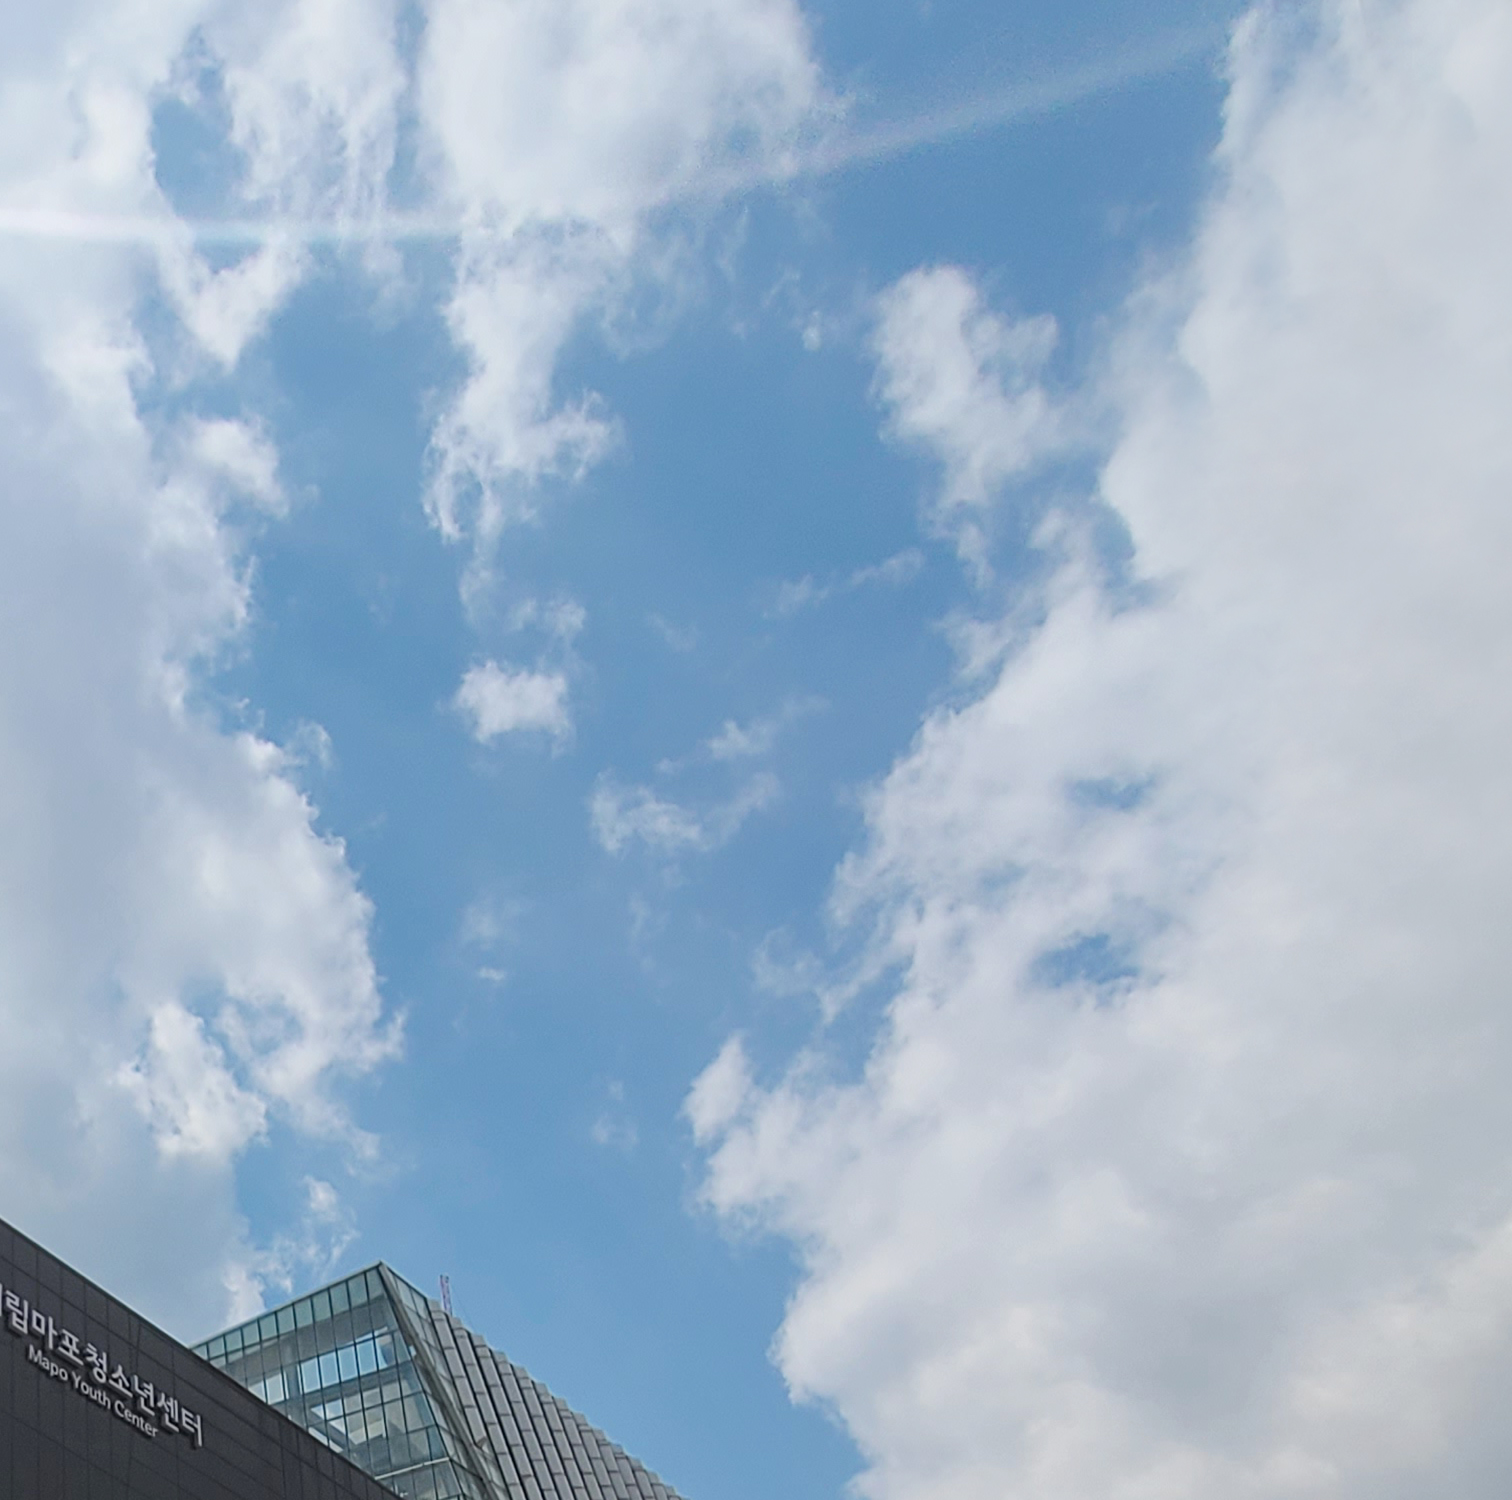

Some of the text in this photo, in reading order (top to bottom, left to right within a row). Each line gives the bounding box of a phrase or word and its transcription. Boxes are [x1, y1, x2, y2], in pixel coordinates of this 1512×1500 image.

[28, 1344, 159, 1438] Mapo Youth Center
